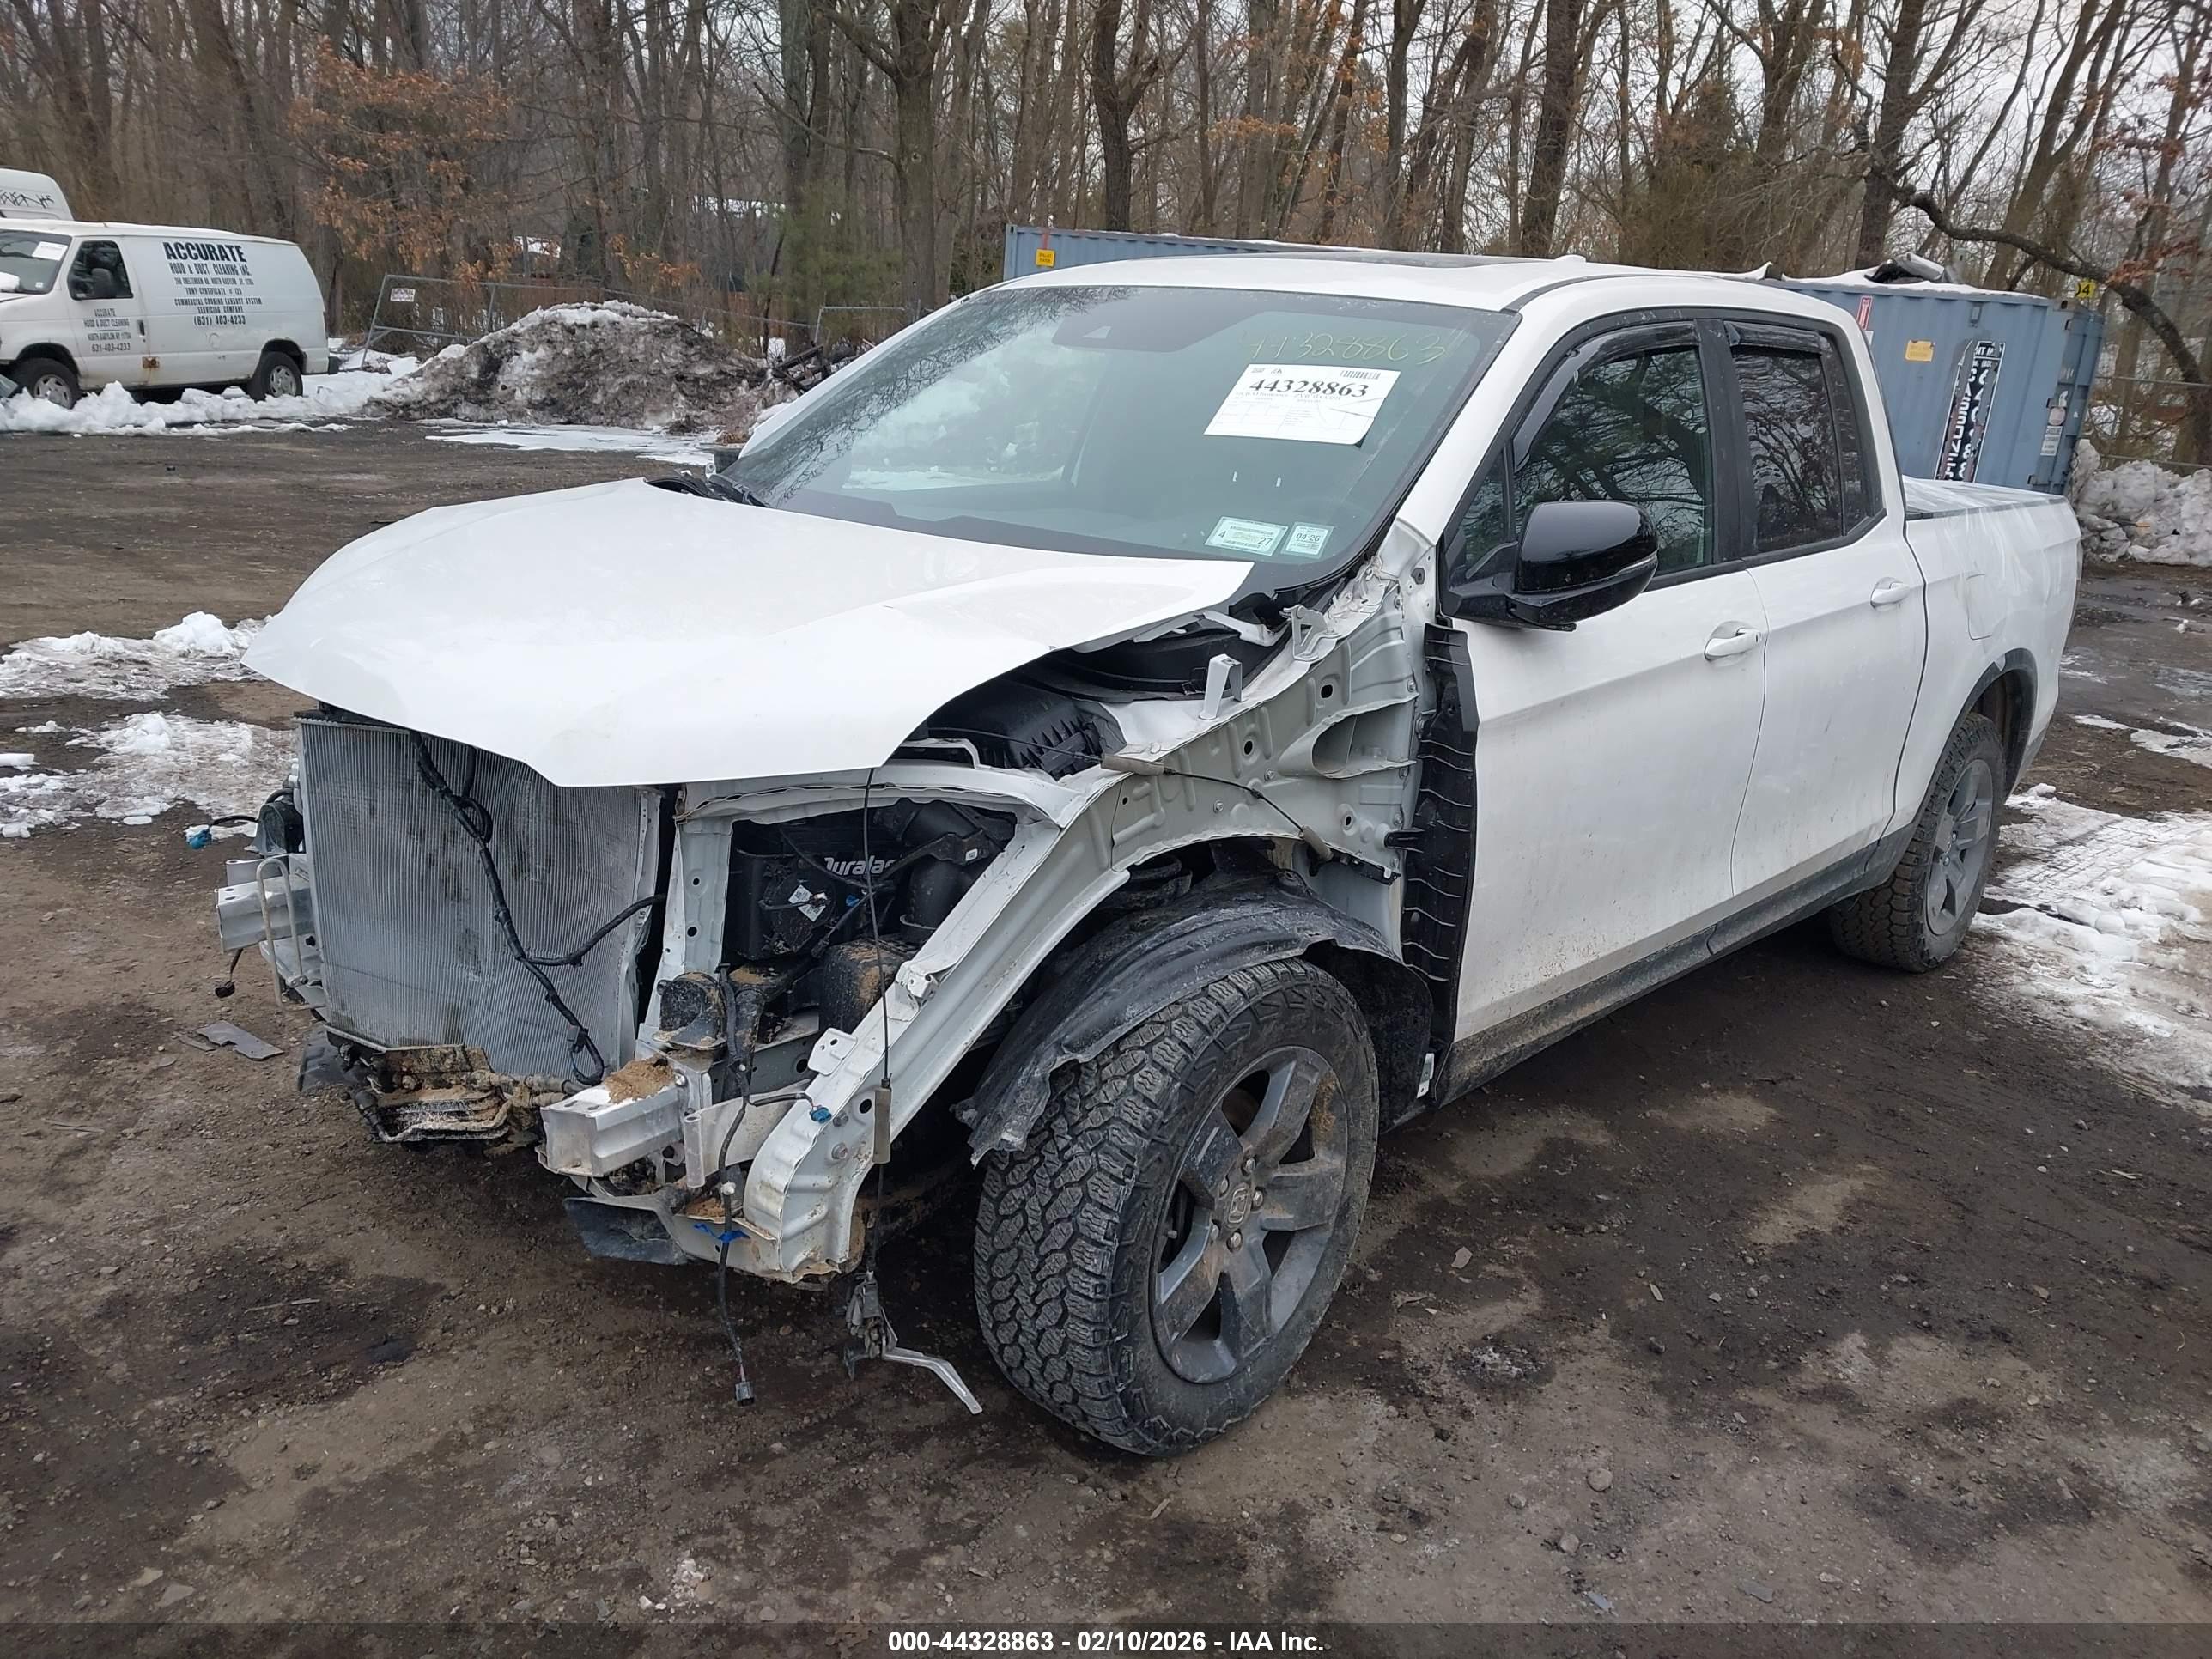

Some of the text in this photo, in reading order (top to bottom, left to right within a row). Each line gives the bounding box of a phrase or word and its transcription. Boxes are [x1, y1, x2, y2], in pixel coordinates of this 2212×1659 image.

[162, 241, 247, 262] ACCURATE
[212, 263, 239, 275] CLEANING
[194, 315, 246, 325] (631) 403-4233
[1249, 378, 1370, 398] 44328863
[1218, 530, 1226, 538] 4
[1258, 537, 1273, 547] 27
